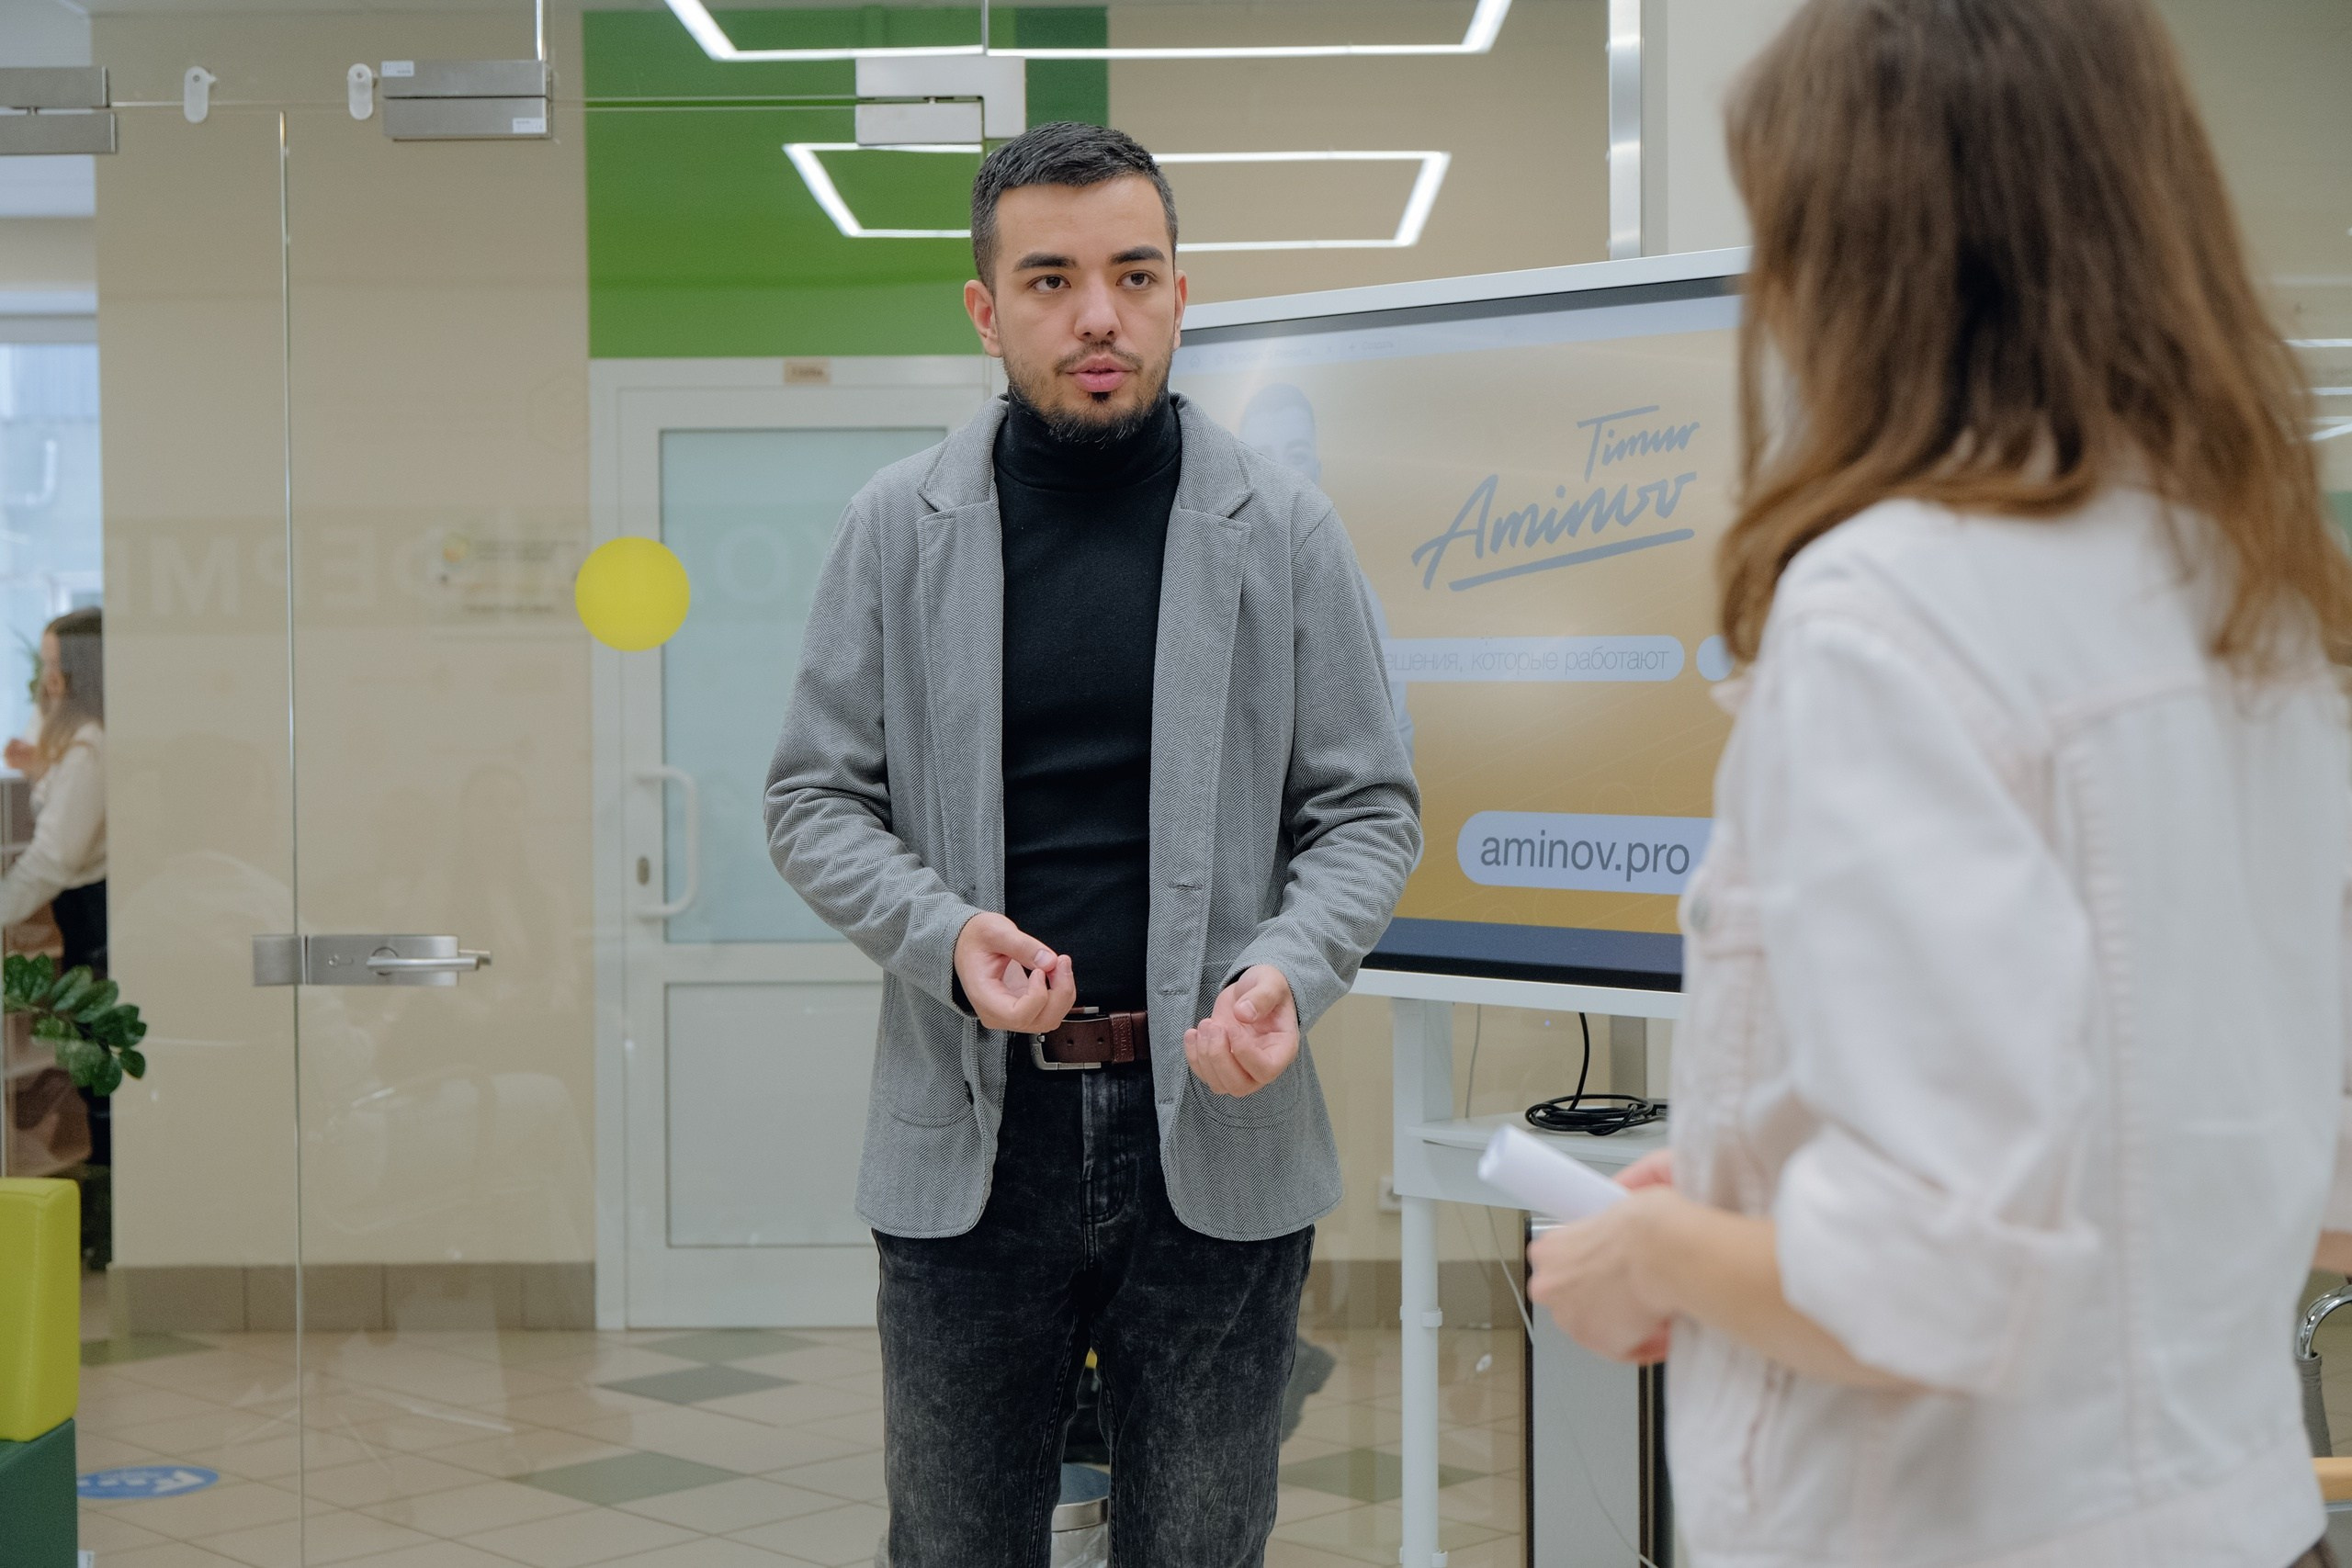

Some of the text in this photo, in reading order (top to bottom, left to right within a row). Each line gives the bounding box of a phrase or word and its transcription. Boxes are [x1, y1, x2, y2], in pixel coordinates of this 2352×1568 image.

[1577, 405, 1700, 483] Timur
[1411, 471, 1697, 590] Aminov
[1384, 646, 1670, 675] ешения, которые работают
[1480, 829, 1690, 883] aminov.pro
